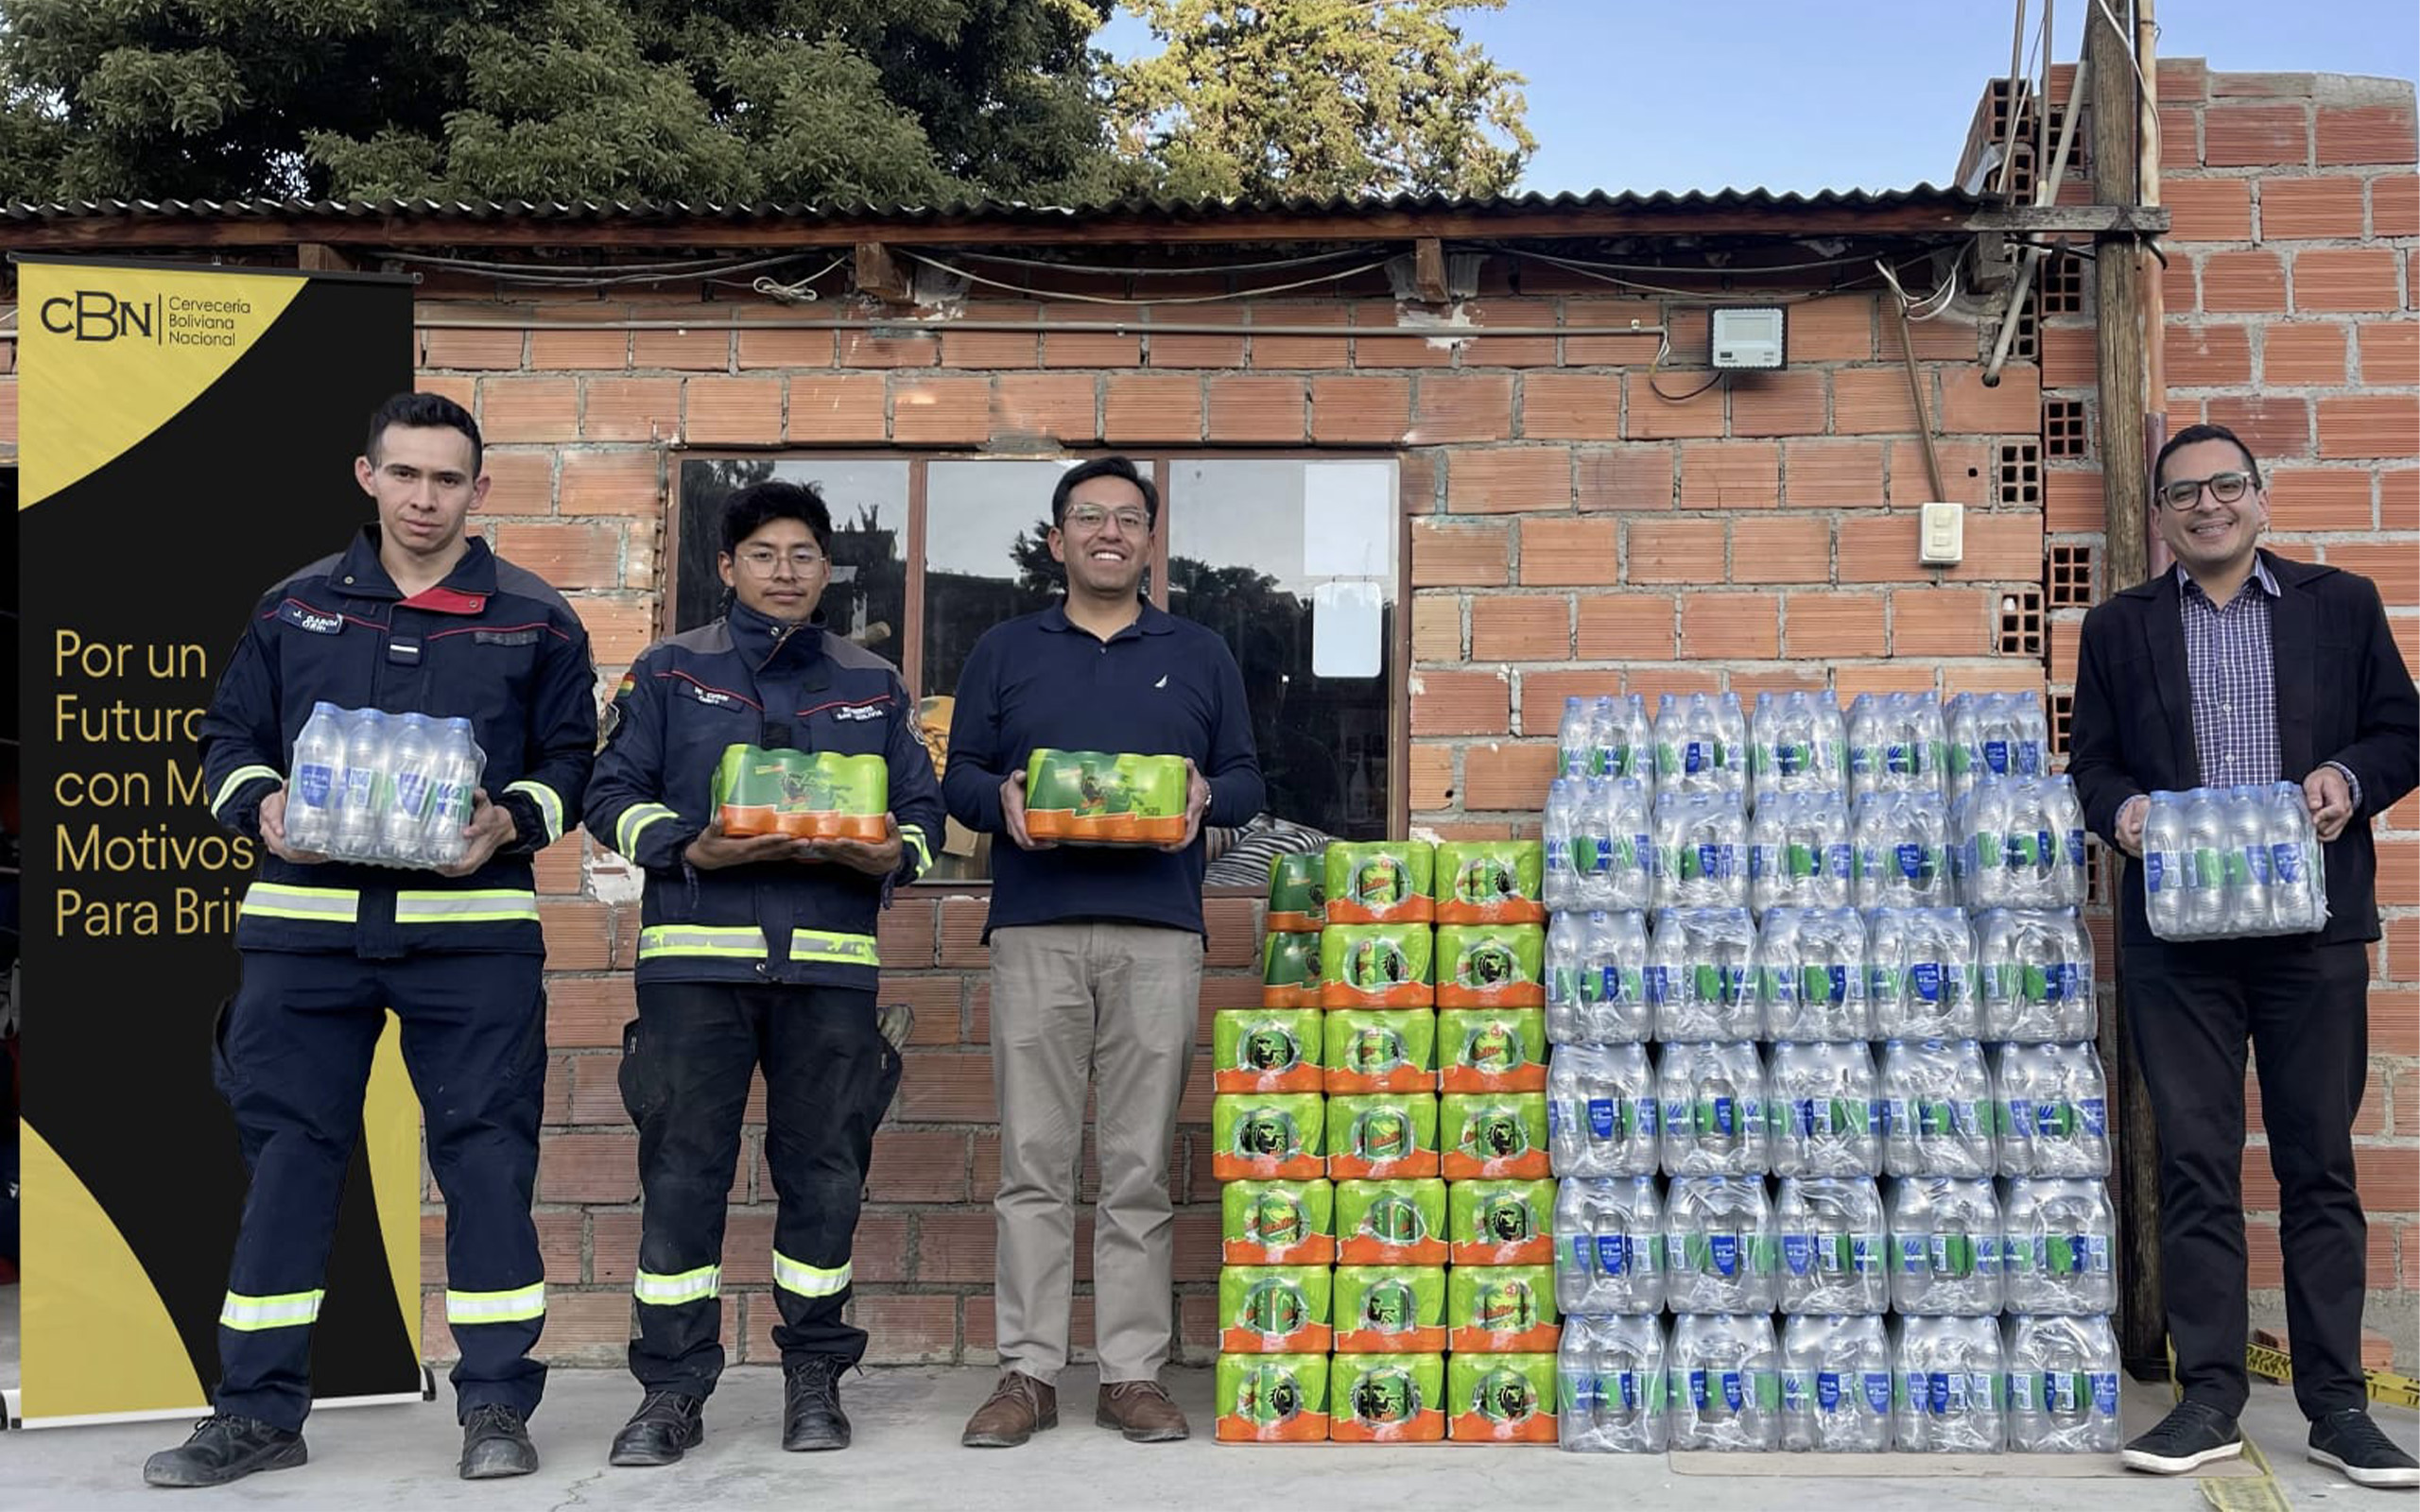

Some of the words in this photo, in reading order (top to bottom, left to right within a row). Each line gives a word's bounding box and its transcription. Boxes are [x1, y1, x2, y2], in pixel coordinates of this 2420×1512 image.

[40, 290, 152, 341] CBN
[169, 296, 251, 314] Cervecería
[169, 314, 234, 330] Boliviana
[169, 331, 235, 347] Nacional
[56, 629, 133, 678] Por
[148, 644, 207, 678] un
[55, 772, 149, 806] con
[56, 823, 255, 871] Motivos
[57, 889, 159, 936] Para
[175, 886, 242, 935] Bri
